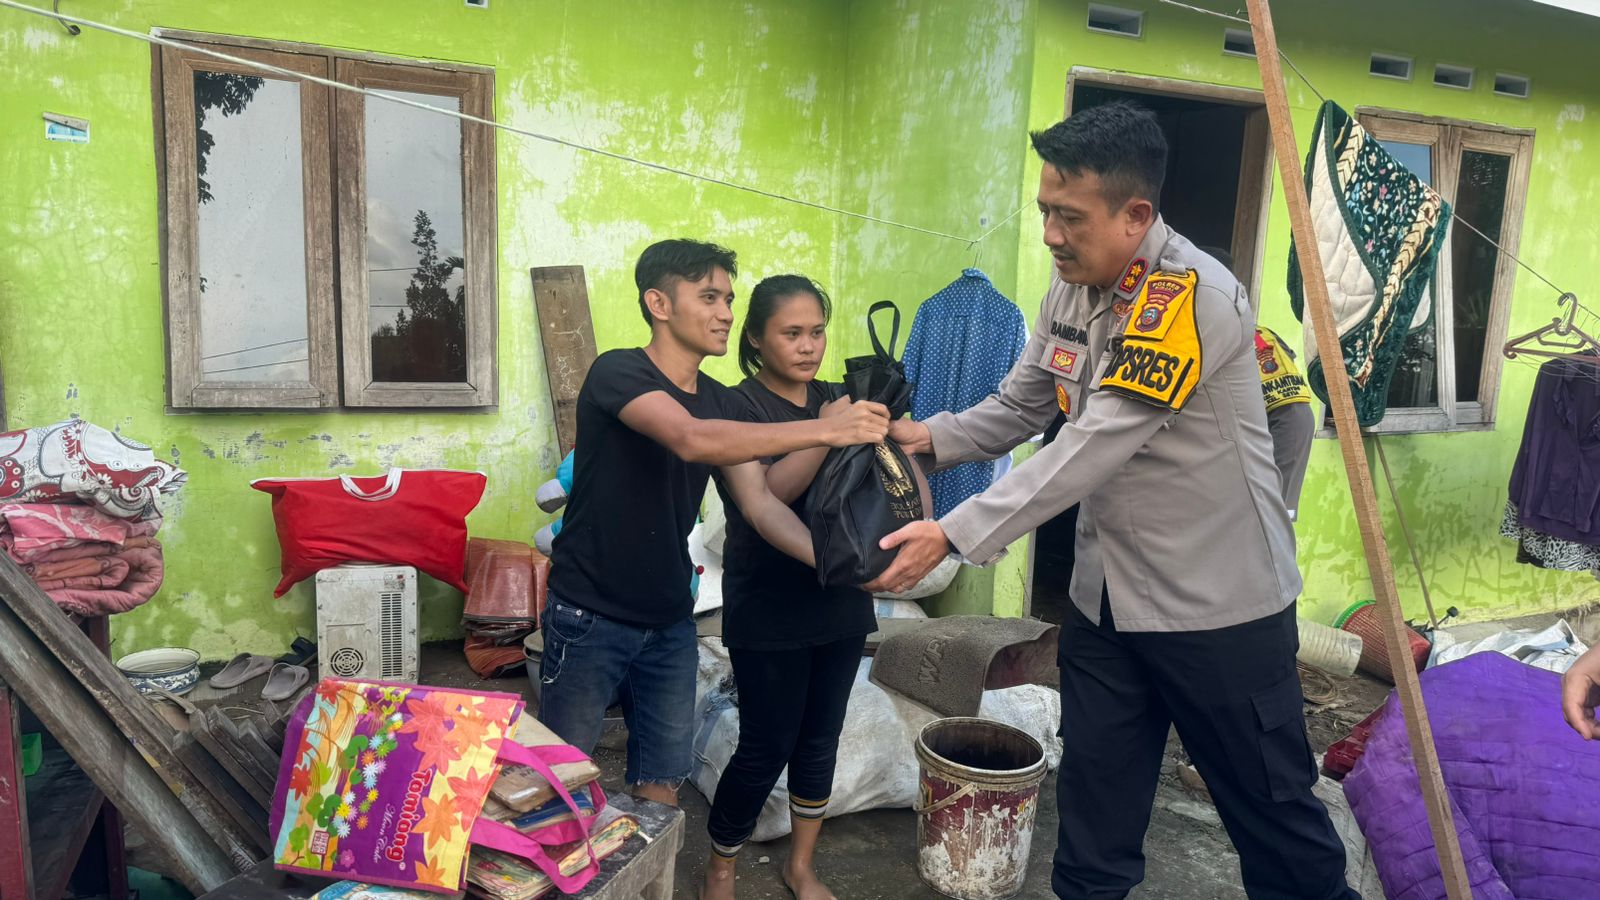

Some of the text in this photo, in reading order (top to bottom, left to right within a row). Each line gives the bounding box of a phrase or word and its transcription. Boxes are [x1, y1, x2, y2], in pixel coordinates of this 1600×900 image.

[1152, 281, 1181, 291] POLRES
[379, 803, 396, 836] Moon
[385, 768, 432, 862] Tamiang
